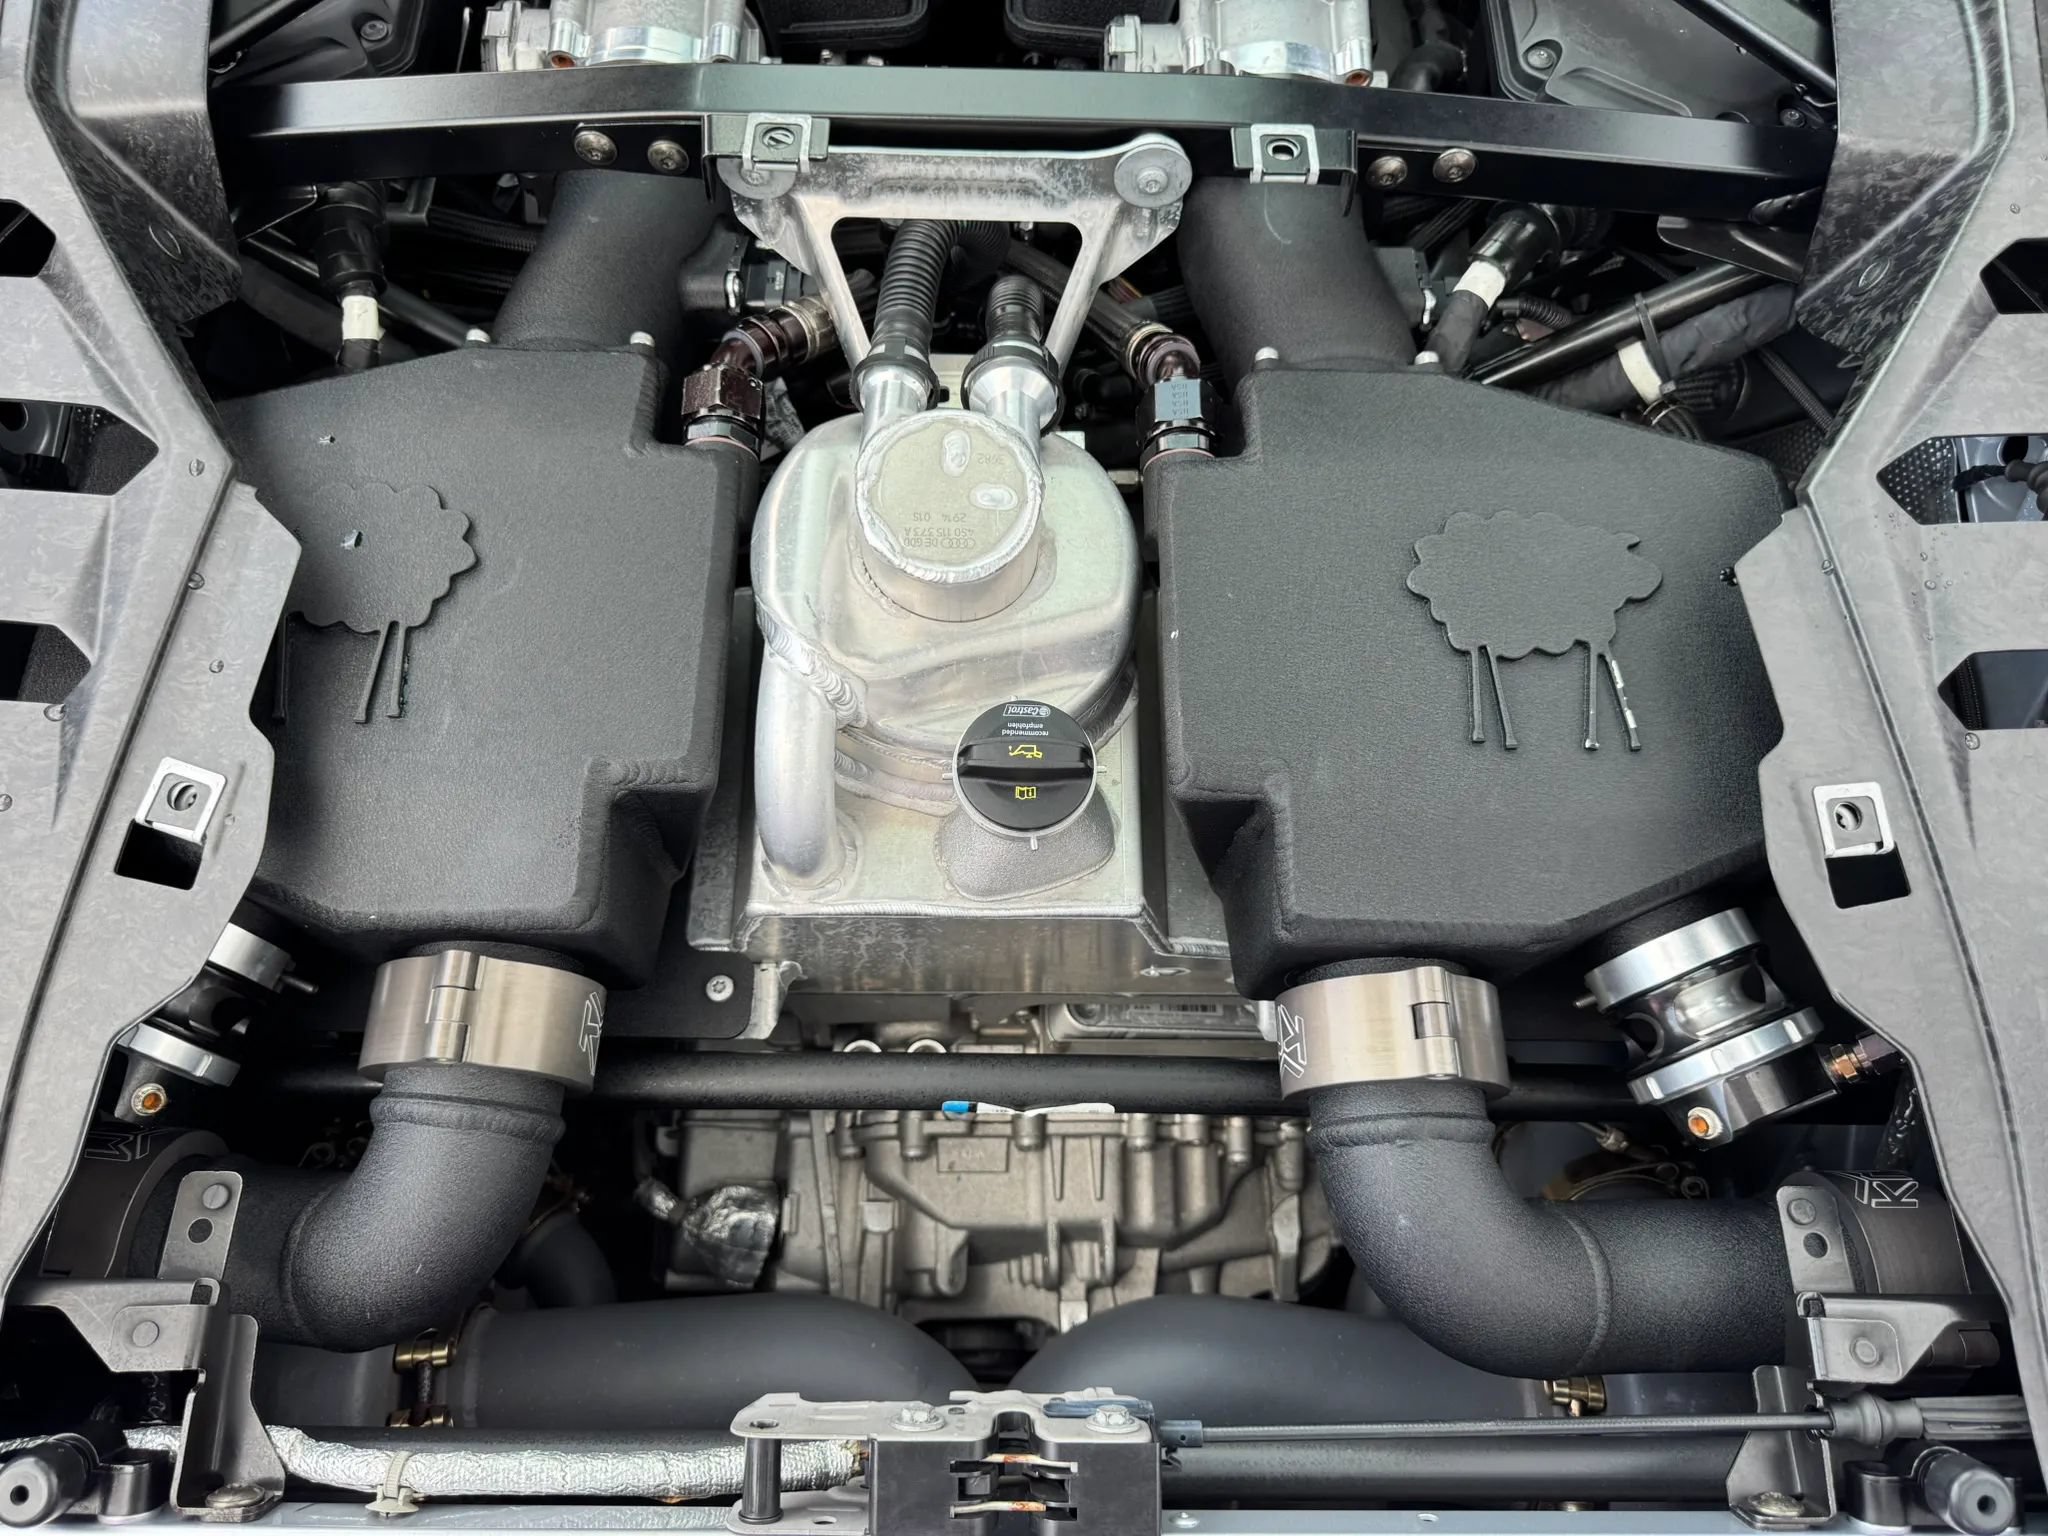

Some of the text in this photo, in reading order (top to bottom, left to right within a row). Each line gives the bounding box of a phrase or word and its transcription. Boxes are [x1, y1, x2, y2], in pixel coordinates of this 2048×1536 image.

[904, 527, 911, 537] A
[913, 527, 934, 537] 373
[936, 527, 951, 537] 115
[924, 538, 938, 548] DE
[1007, 706, 1039, 715] Castrol
[1007, 722, 1044, 730] empfohlen
[1001, 729, 1049, 737] recommended
